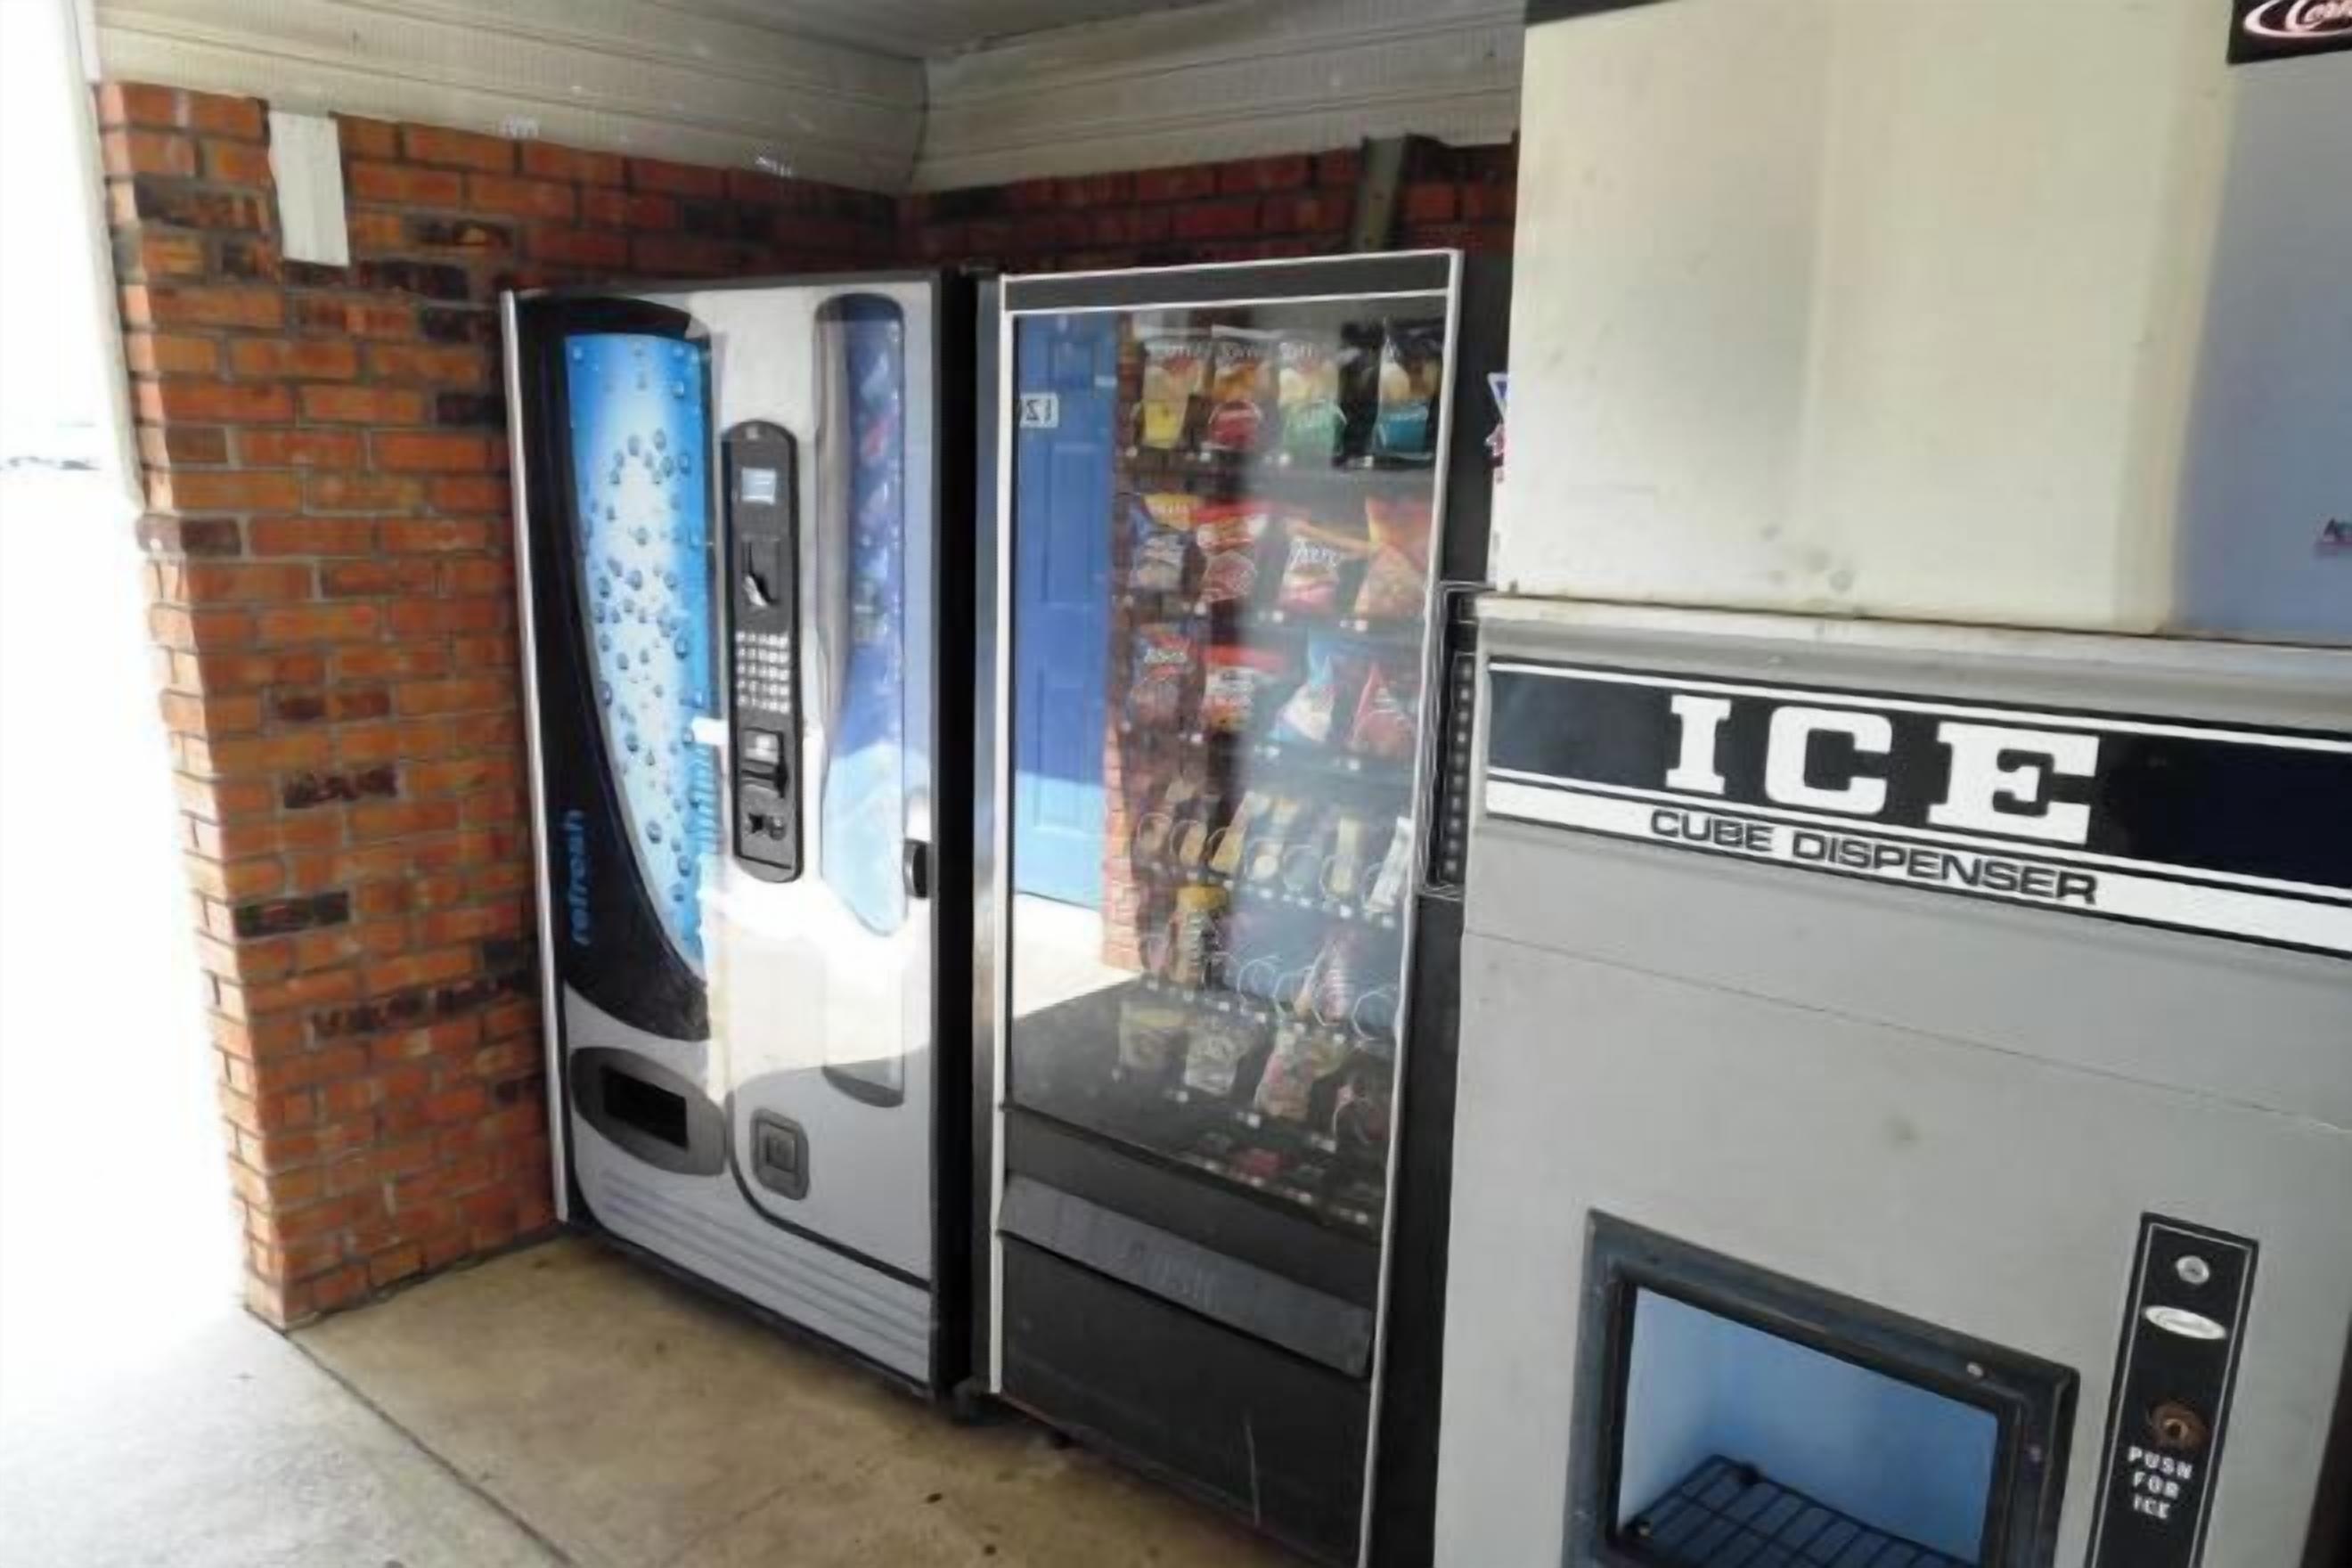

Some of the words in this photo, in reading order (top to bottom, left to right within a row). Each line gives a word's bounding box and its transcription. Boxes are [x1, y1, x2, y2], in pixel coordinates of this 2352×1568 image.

[1664, 694, 2101, 846] ICE
[1650, 808, 1776, 853] CUBE
[1790, 830, 2100, 906] DISPENSER
[2127, 1445, 2193, 1480] PUSH
[2133, 1471, 2180, 1499] FOR
[2133, 1494, 2170, 1519] ICE
